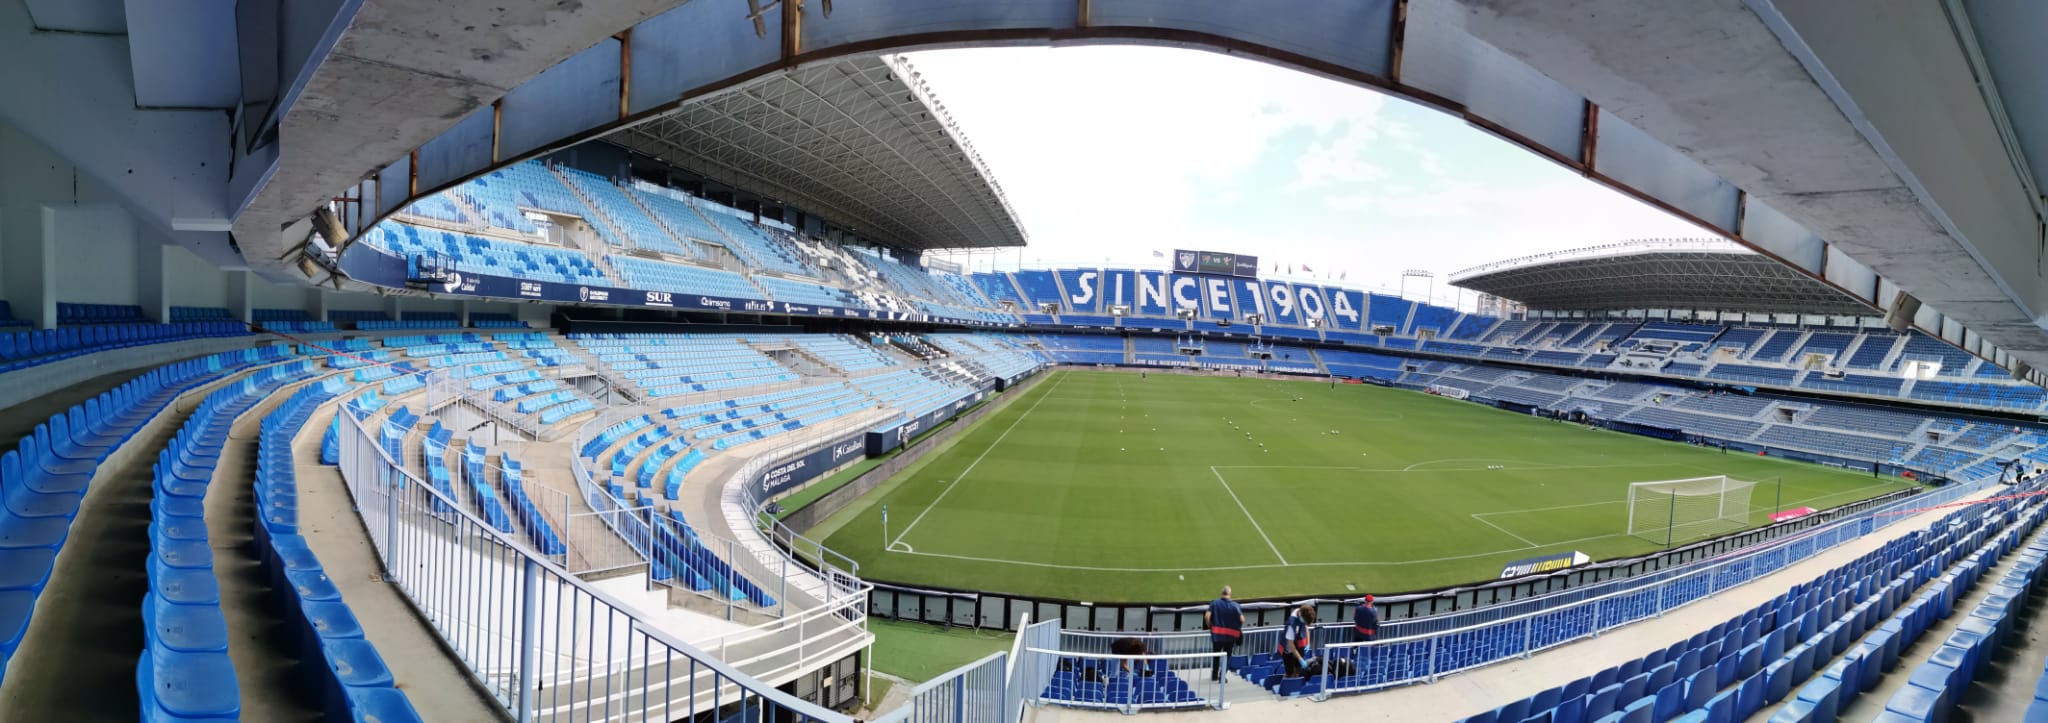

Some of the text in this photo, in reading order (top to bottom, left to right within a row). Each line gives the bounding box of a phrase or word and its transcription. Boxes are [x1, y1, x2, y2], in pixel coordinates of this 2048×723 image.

[646, 291, 672, 303] SUR
[1072, 272, 1359, 323] SINCE 1904
[770, 466, 786, 478] COSTA
[786, 462, 797, 473] DEL
